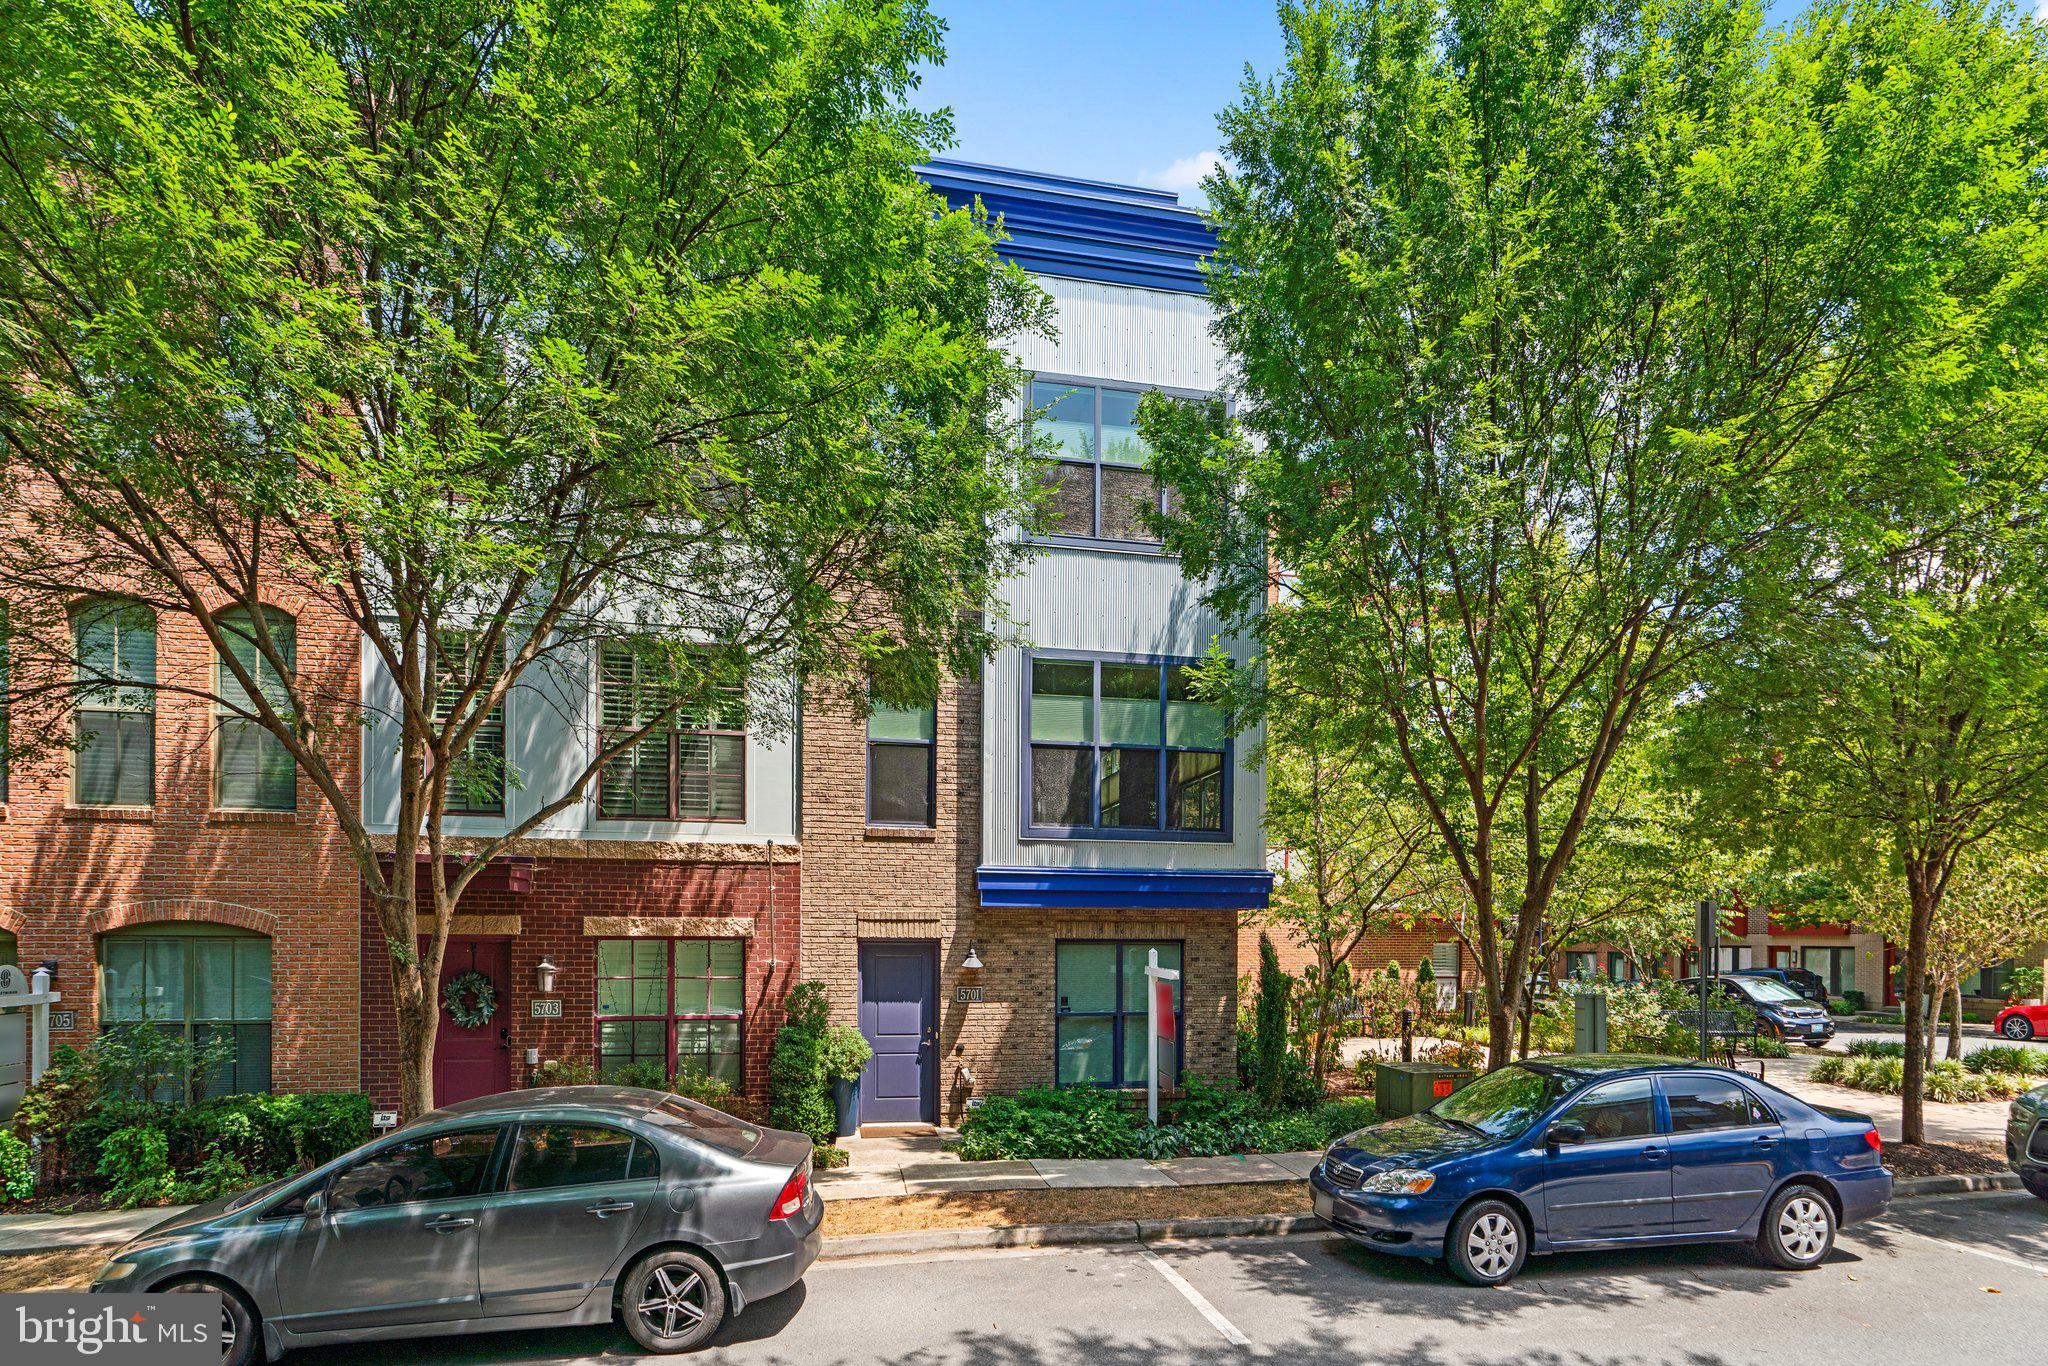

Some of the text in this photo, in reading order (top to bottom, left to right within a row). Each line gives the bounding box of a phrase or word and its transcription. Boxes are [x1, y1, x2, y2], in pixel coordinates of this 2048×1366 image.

[960, 989, 980, 1001] 5701
[534, 1002, 559, 1015] 5703
[50, 1014, 70, 1027] 705
